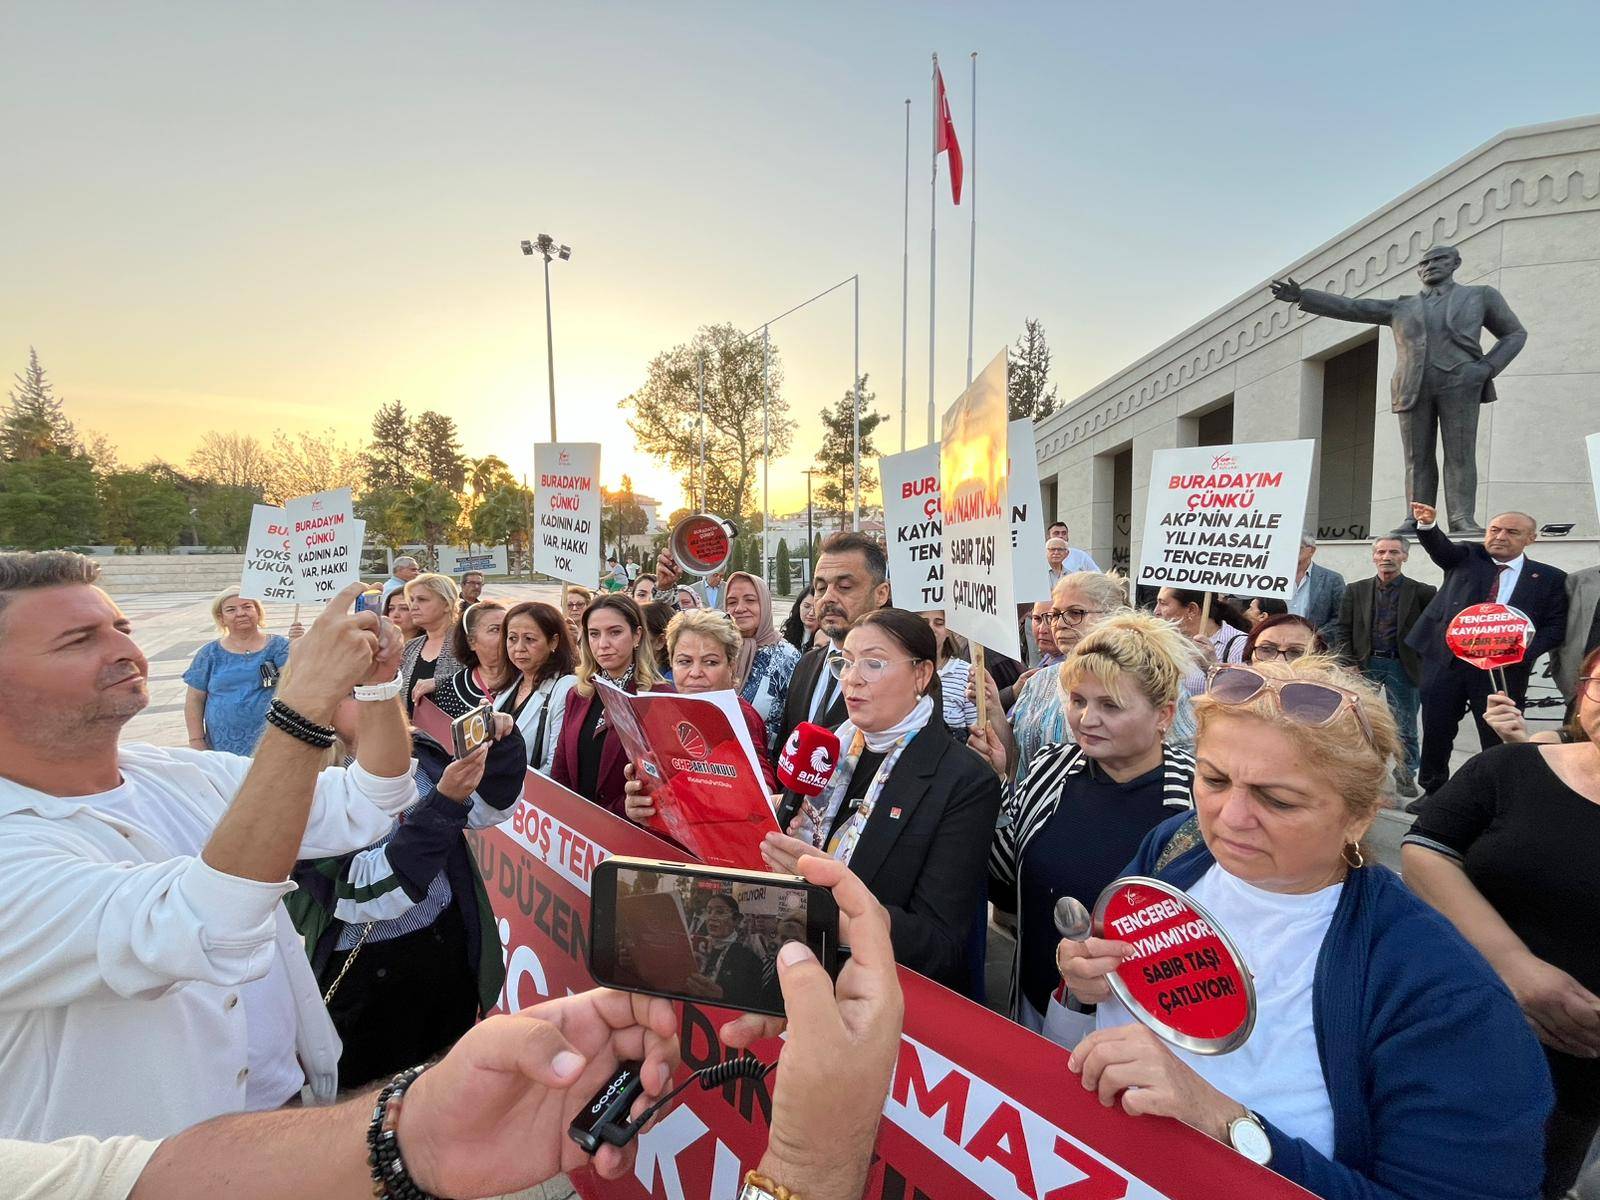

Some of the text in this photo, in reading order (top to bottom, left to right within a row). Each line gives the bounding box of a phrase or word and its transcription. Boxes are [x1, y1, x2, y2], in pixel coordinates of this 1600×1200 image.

[541, 474, 591, 491] BURADAYIM
[902, 476, 941, 499] BUR
[1168, 472, 1283, 490] BURADAYIM
[550, 493, 580, 511] ÇÜNKÜ
[1187, 490, 1255, 512] ÇÜNKÜ
[295, 513, 344, 532] BURADAYIM
[541, 513, 591, 534] KADININ ADI
[1160, 509, 1282, 529] AKP'NİN AİLE
[306, 529, 335, 549] ÇÜNKÜ
[543, 533, 588, 555] VAR, HAKKI
[1165, 531, 1272, 549] YILI MASALI
[298, 545, 348, 563] KADININ ADI
[554, 556, 573, 572] YOK.
[951, 536, 972, 565] SABIR
[975, 536, 995, 574] TAŞI
[1163, 549, 1270, 570] TENCEREMİ
[321, 562, 348, 575] HAKKI
[1142, 565, 1289, 592] DOLDURMUYOR
[315, 580, 335, 592] YOK.
[953, 579, 997, 615] ÇATLIYOR!
[799, 770, 828, 785] anka
[512, 801, 552, 862] BOŞ
[1111, 899, 1187, 937] TENCEREM
[1143, 947, 1221, 985] SABIR TAŞI
[1158, 975, 1237, 1015] ÇATLIYOR!
